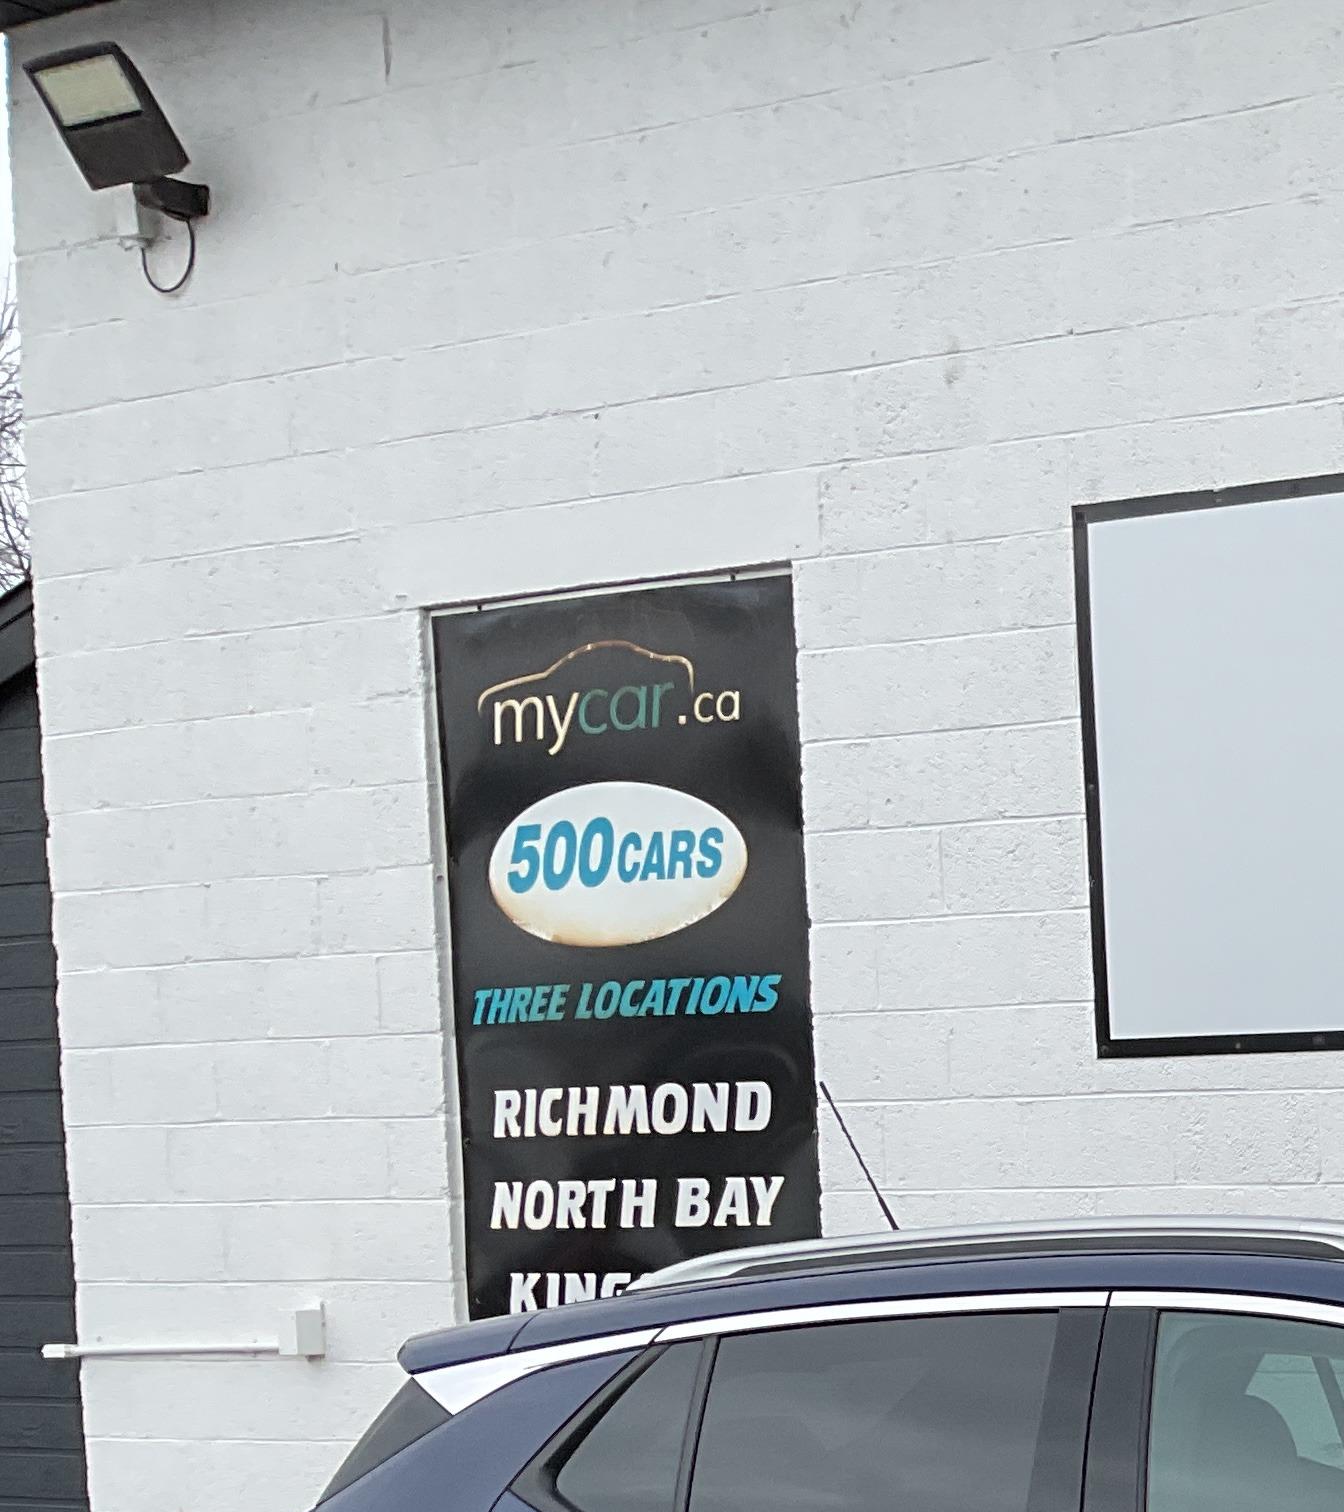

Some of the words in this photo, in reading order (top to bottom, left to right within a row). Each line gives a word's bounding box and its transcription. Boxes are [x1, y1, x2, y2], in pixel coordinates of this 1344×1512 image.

[472, 984, 570, 1026] THREE
[574, 973, 783, 1020] LOCATIONS
[493, 1080, 773, 1139] RICHMOND
[489, 1177, 658, 1231] NORTH
[674, 1176, 785, 1229] BAY
[509, 1272, 652, 1315] KING
